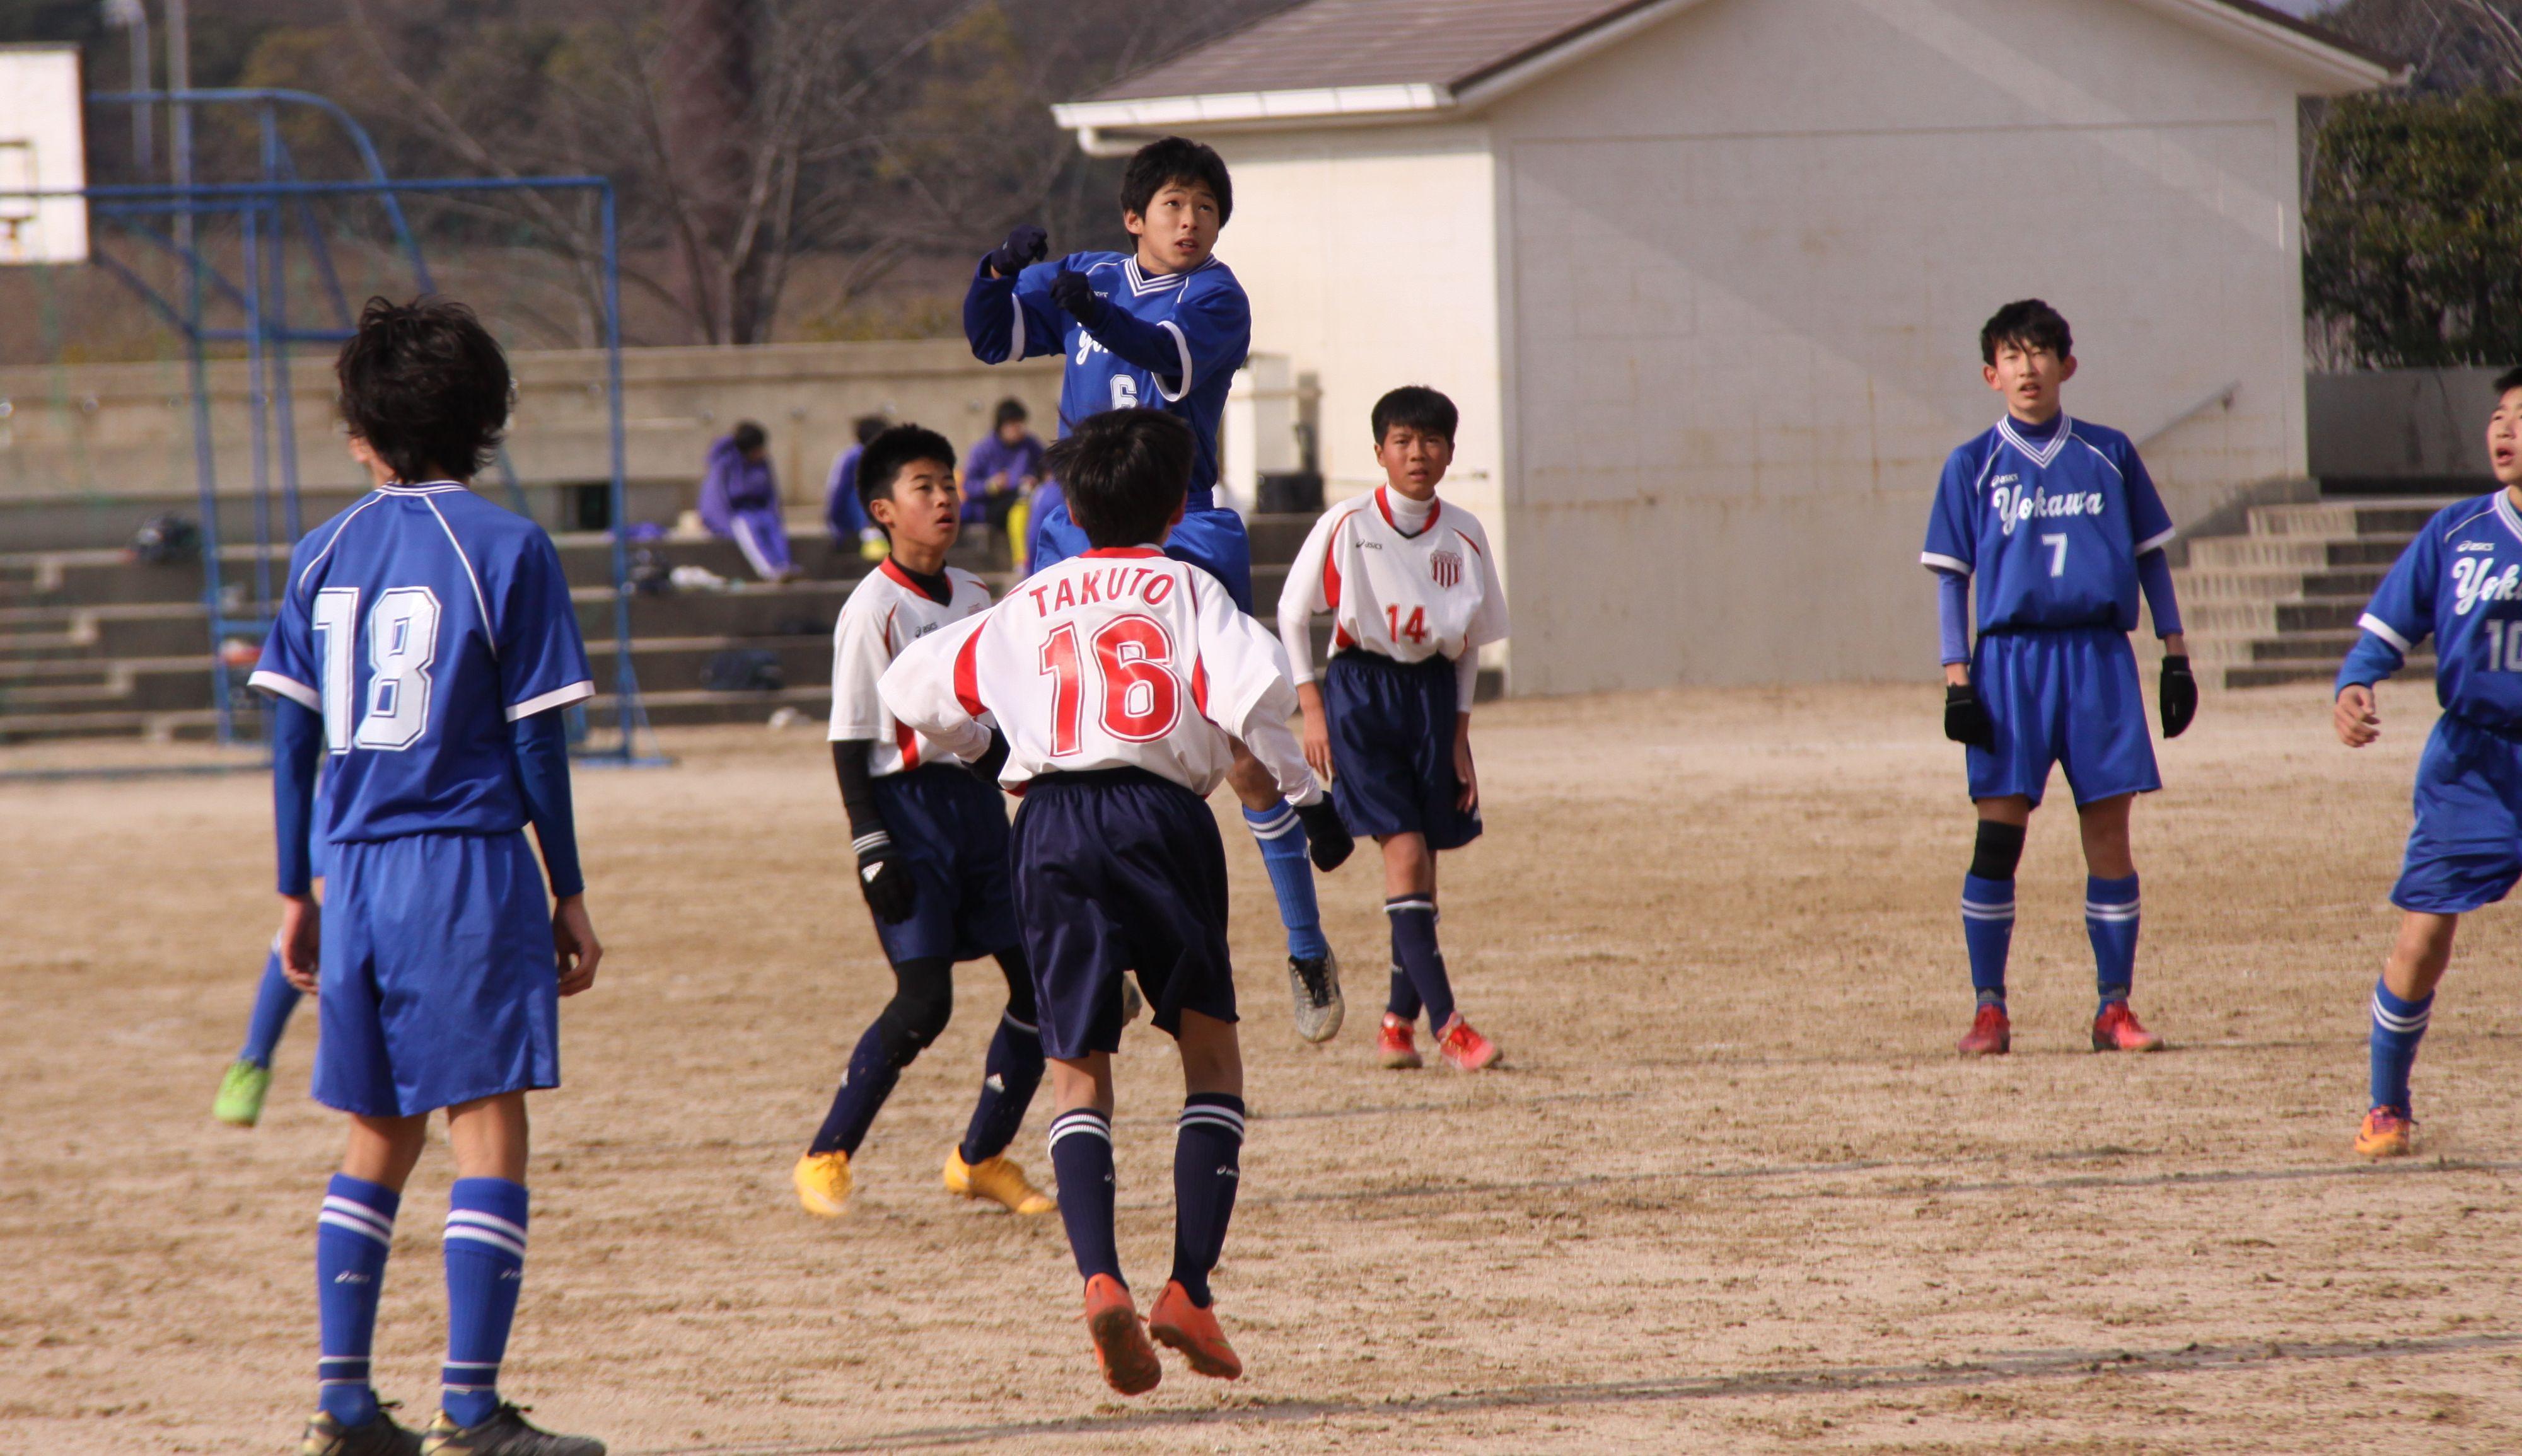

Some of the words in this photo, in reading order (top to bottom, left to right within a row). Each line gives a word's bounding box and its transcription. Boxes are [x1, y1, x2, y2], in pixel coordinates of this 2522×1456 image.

[1110, 374, 1138, 410] 6
[1992, 484, 2105, 535] Yokawa
[2042, 533, 2068, 577] 7
[1029, 567, 1175, 618] TAKUTO
[2453, 557, 2522, 615] Yok
[1385, 603, 1427, 645] 14
[311, 586, 441, 755] 18
[1039, 613, 1182, 757] 16
